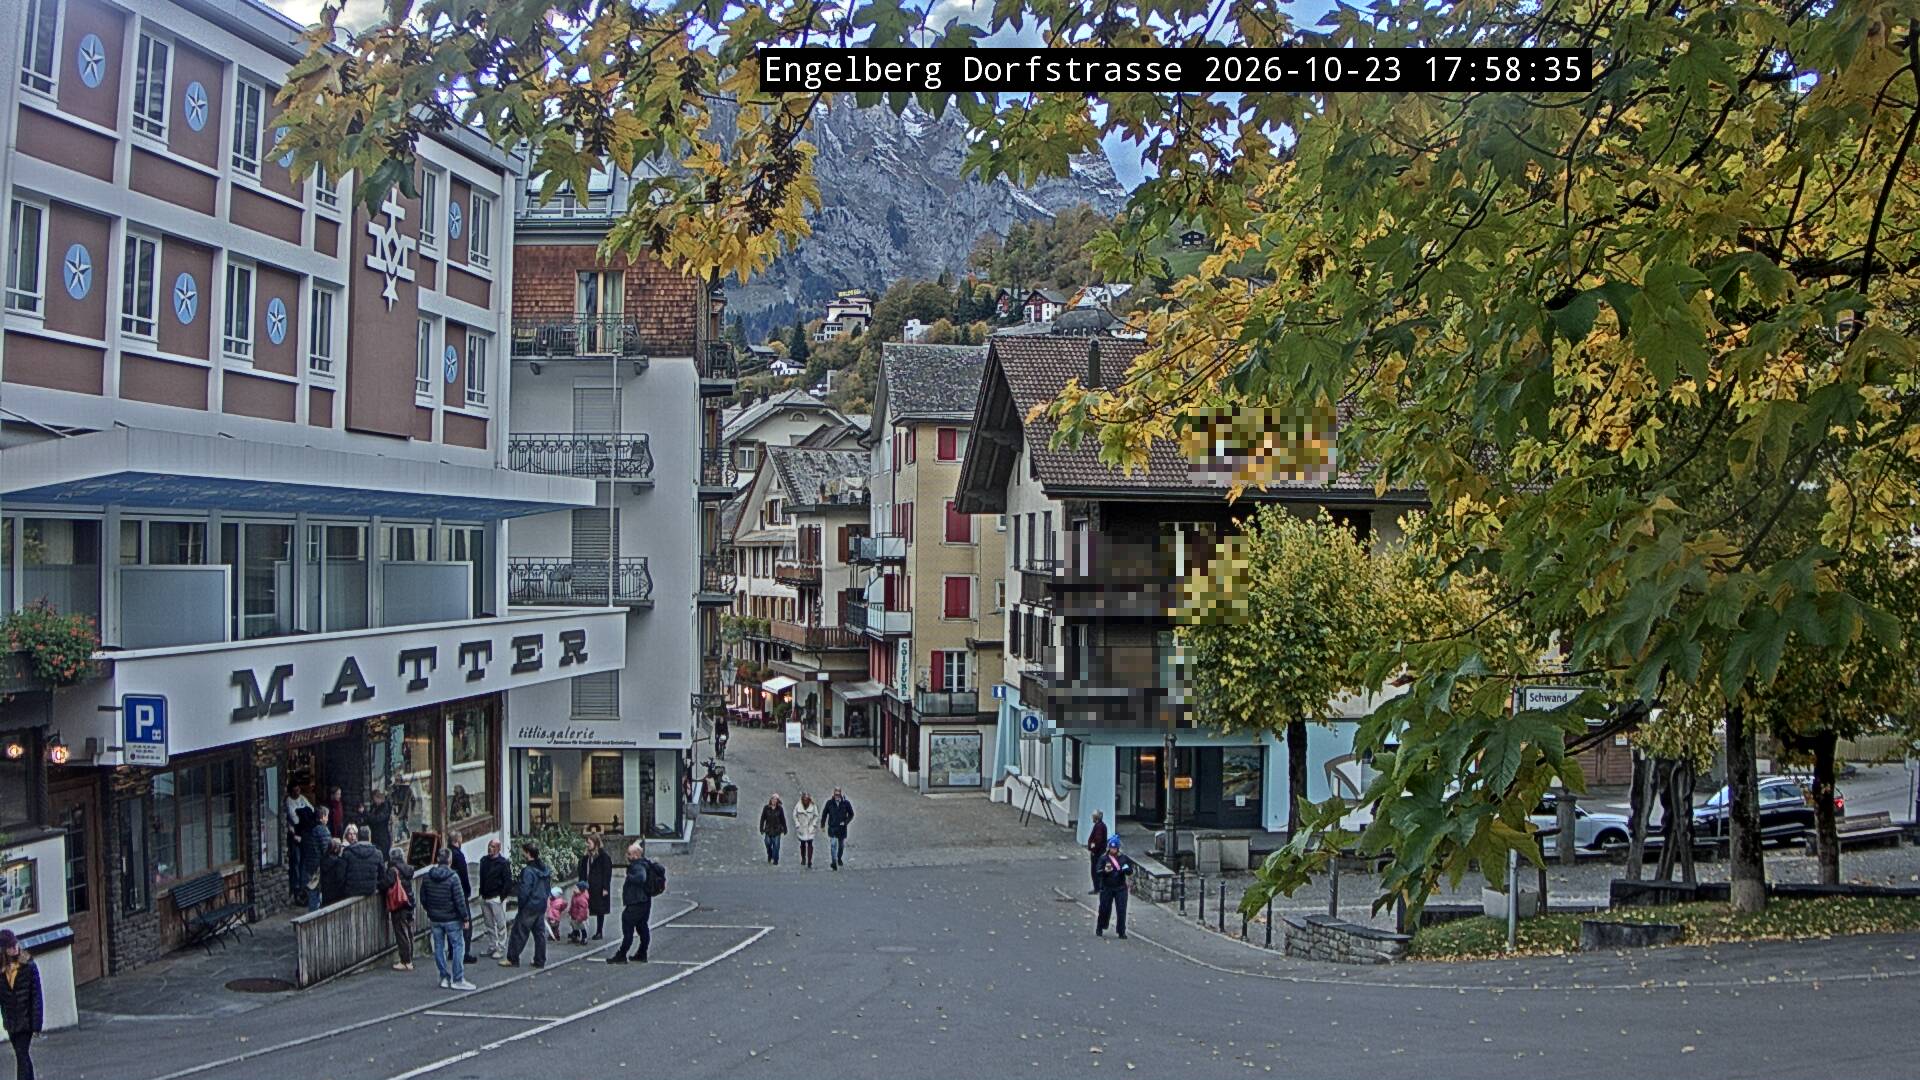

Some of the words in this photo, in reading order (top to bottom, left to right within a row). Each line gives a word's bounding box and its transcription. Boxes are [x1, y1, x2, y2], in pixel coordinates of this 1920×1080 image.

[231, 629, 588, 722] MATTER
[1529, 692, 1568, 703] Schwand
[136, 704, 154, 738] P
[518, 725, 595, 744] titlis.galerie
